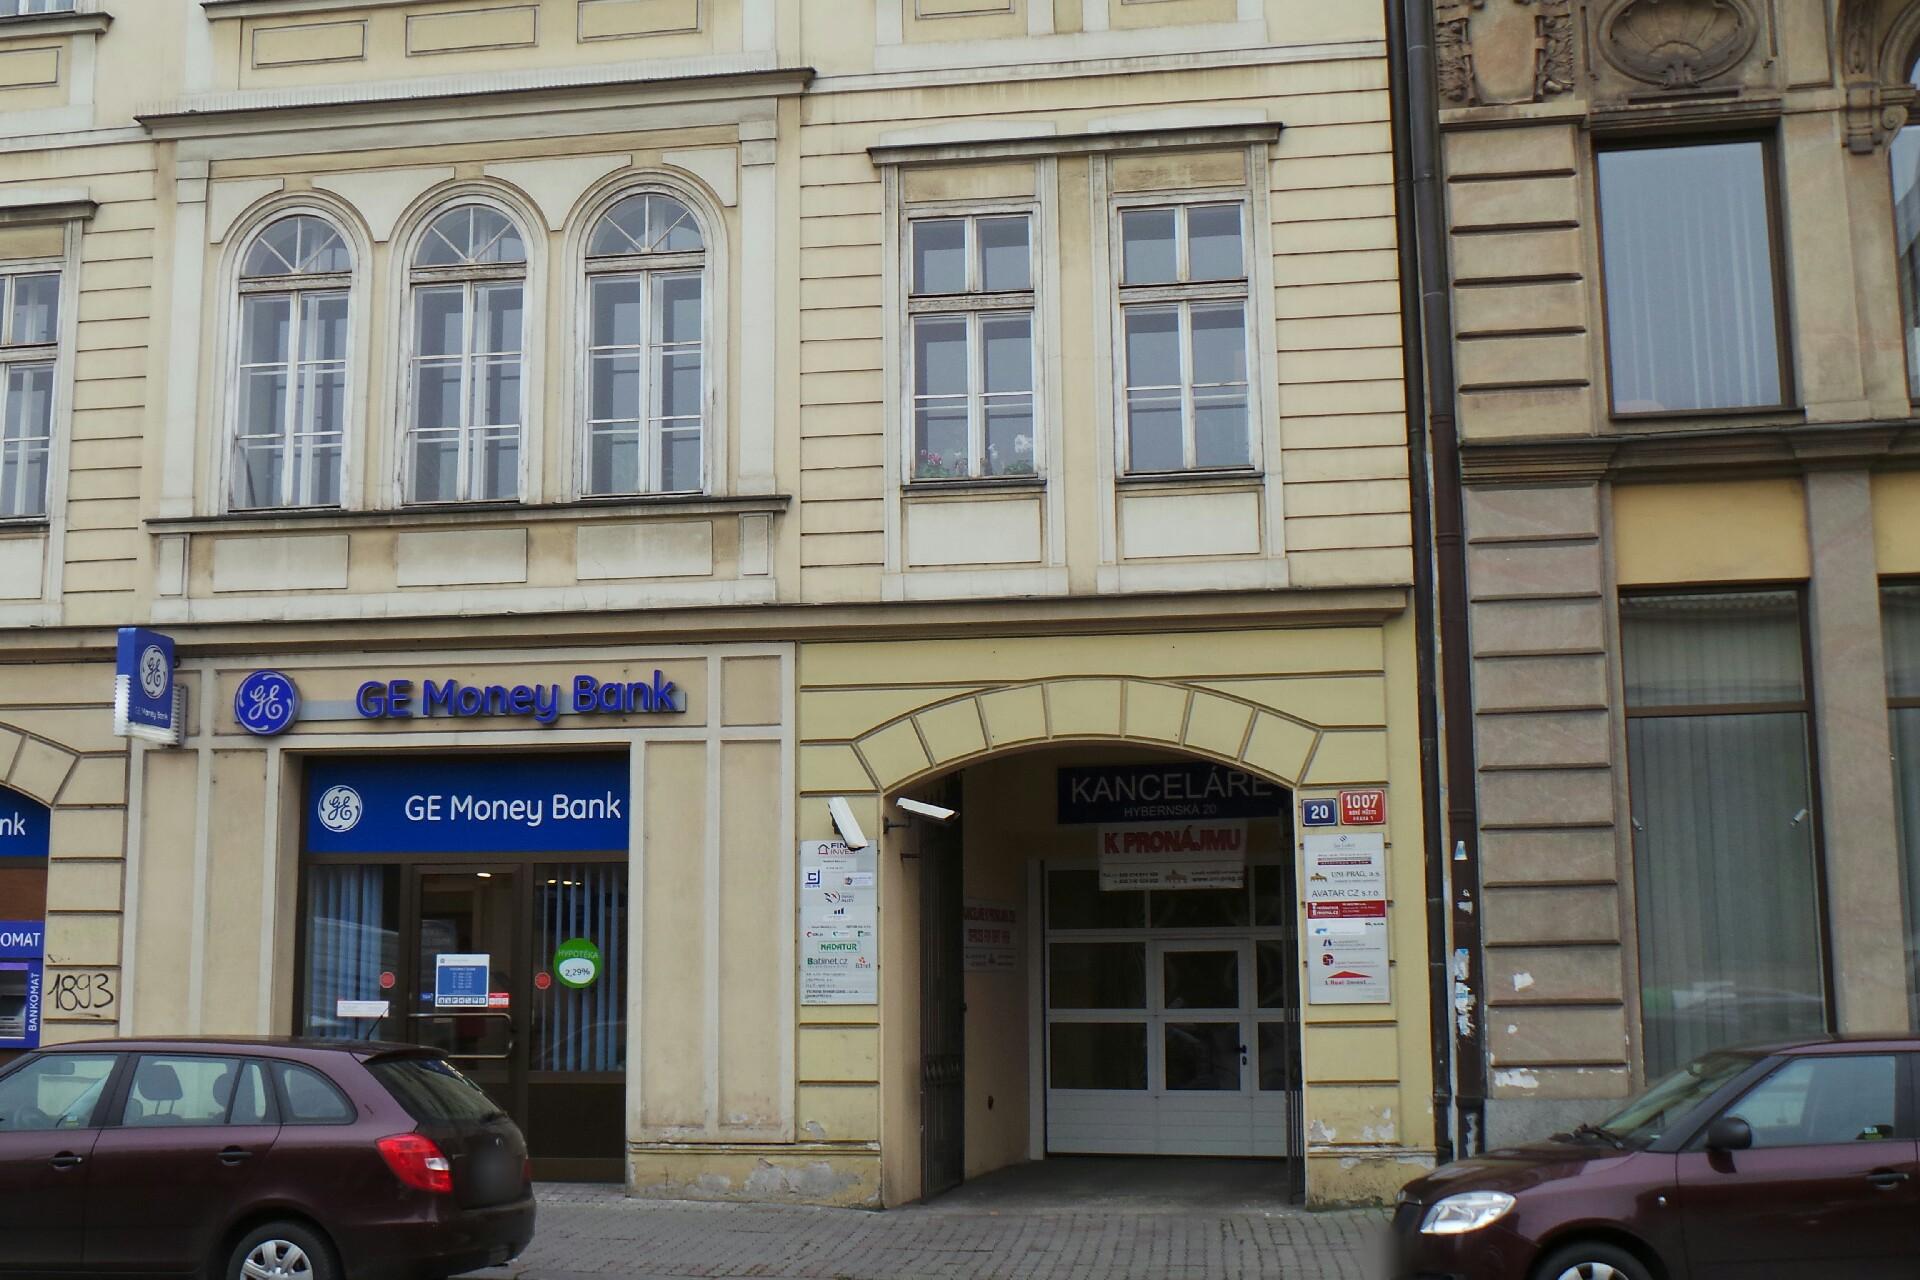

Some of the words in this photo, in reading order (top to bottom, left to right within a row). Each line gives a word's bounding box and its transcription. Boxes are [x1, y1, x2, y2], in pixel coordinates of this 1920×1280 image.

[355, 679, 414, 717] GE
[422, 678, 561, 725] Money
[572, 669, 677, 713] Bank
[404, 794, 442, 821] GE
[450, 794, 543, 827] Money
[552, 790, 622, 820] Bank
[1202, 803, 1217, 815] 20
[1310, 804, 1329, 820] 20
[1345, 794, 1379, 809] 1007
[1103, 832, 1120, 854] K
[1123, 825, 1242, 854] PRONÁJMU
[1311, 888, 1345, 898] AVATAR
[1347, 889, 1359, 897] CZ
[28, 971, 41, 1032] BANKOMAT
[47, 972, 115, 1012] 1893
